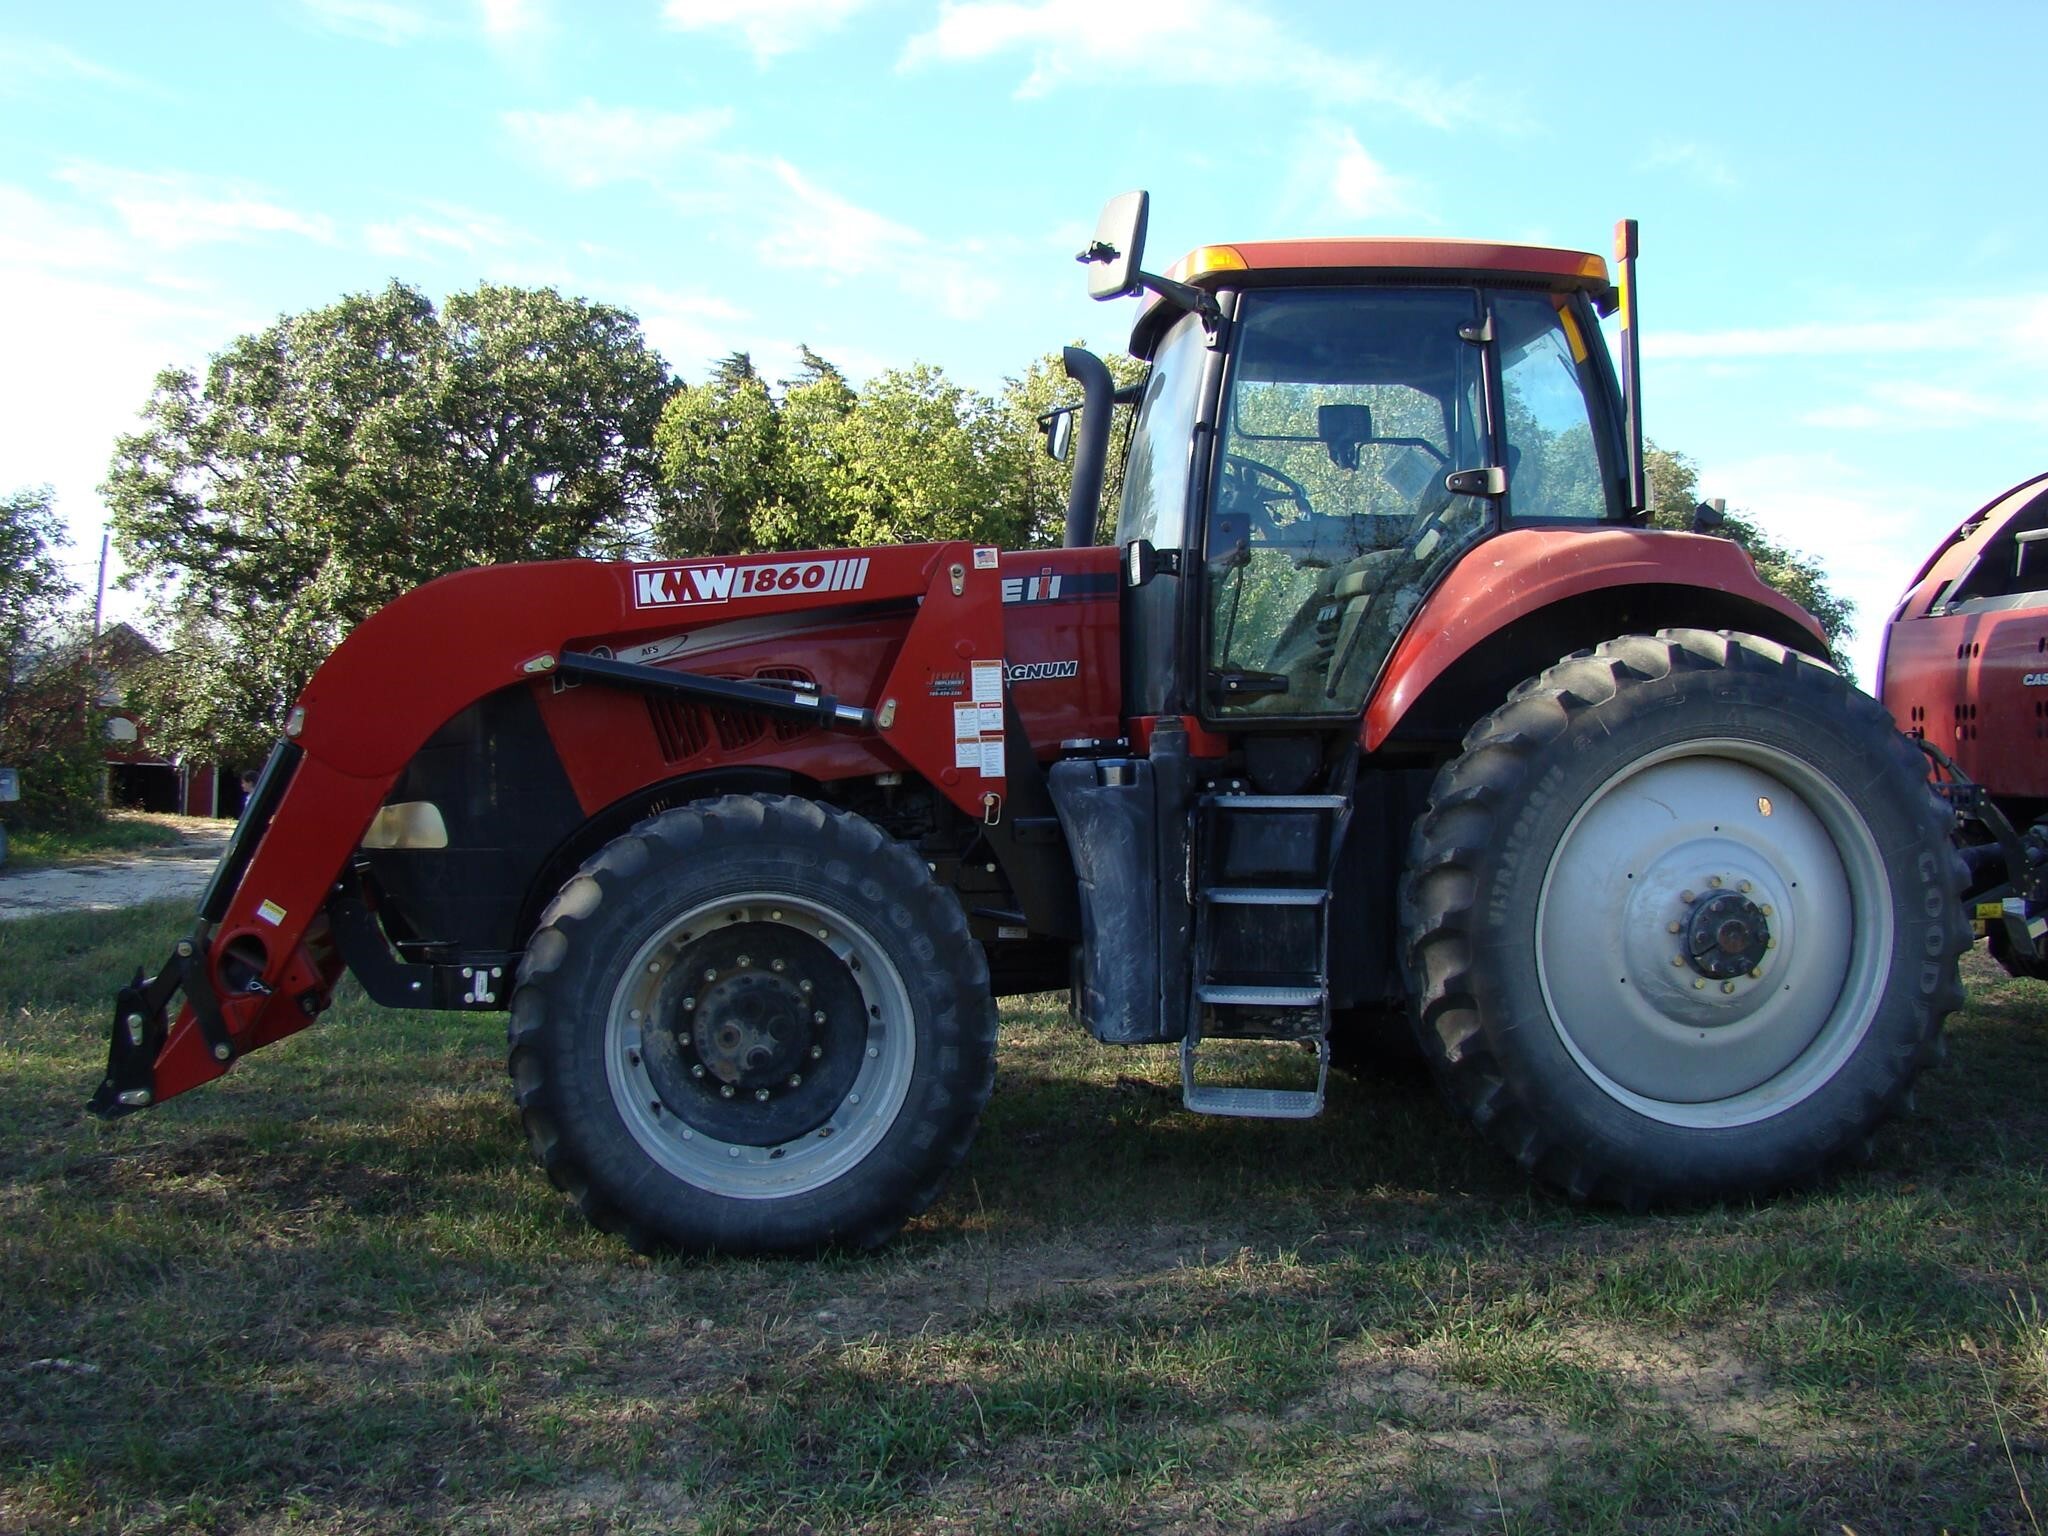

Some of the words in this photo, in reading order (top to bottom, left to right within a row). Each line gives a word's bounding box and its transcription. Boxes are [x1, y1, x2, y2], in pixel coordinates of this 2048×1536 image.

[637, 566, 735, 605] KMW
[741, 565, 826, 593] 1860
[641, 645, 659, 656] AFS
[2022, 672, 2048, 686] CAS
